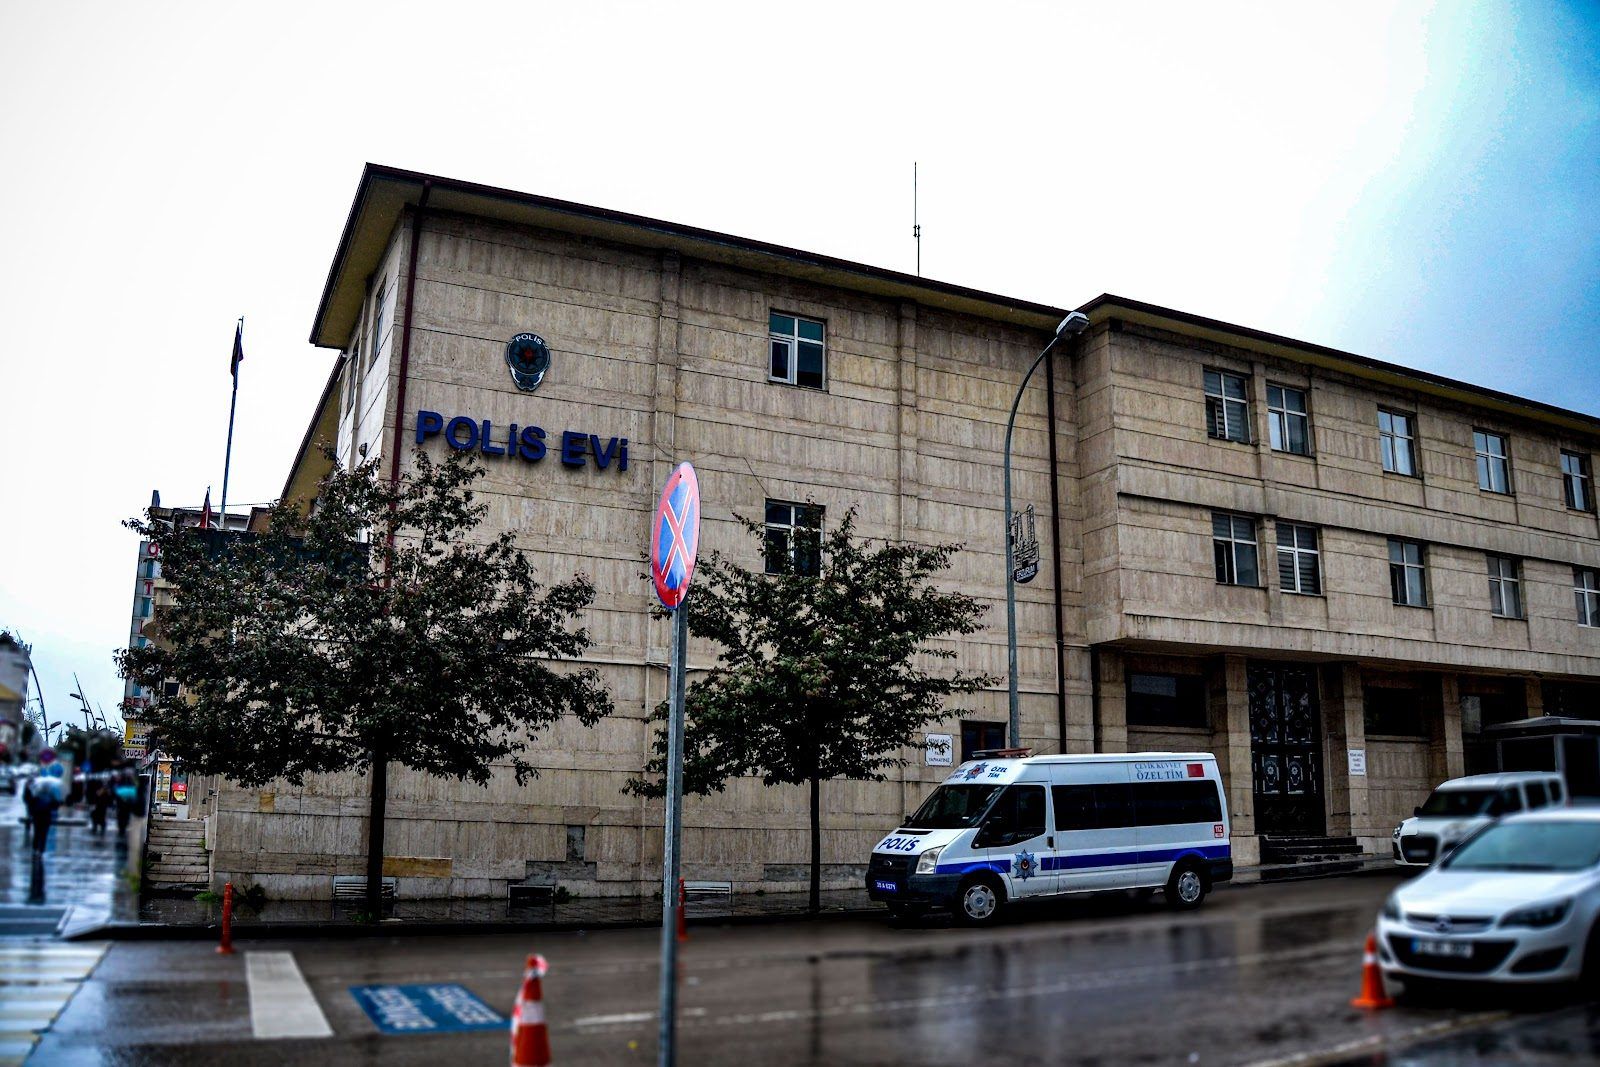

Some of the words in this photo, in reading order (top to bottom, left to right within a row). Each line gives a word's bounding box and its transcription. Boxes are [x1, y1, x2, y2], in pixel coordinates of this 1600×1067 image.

[1136, 769, 1163, 780] ÖZEL
[1166, 769, 1183, 779] TİM
[878, 837, 920, 851] POLİS
